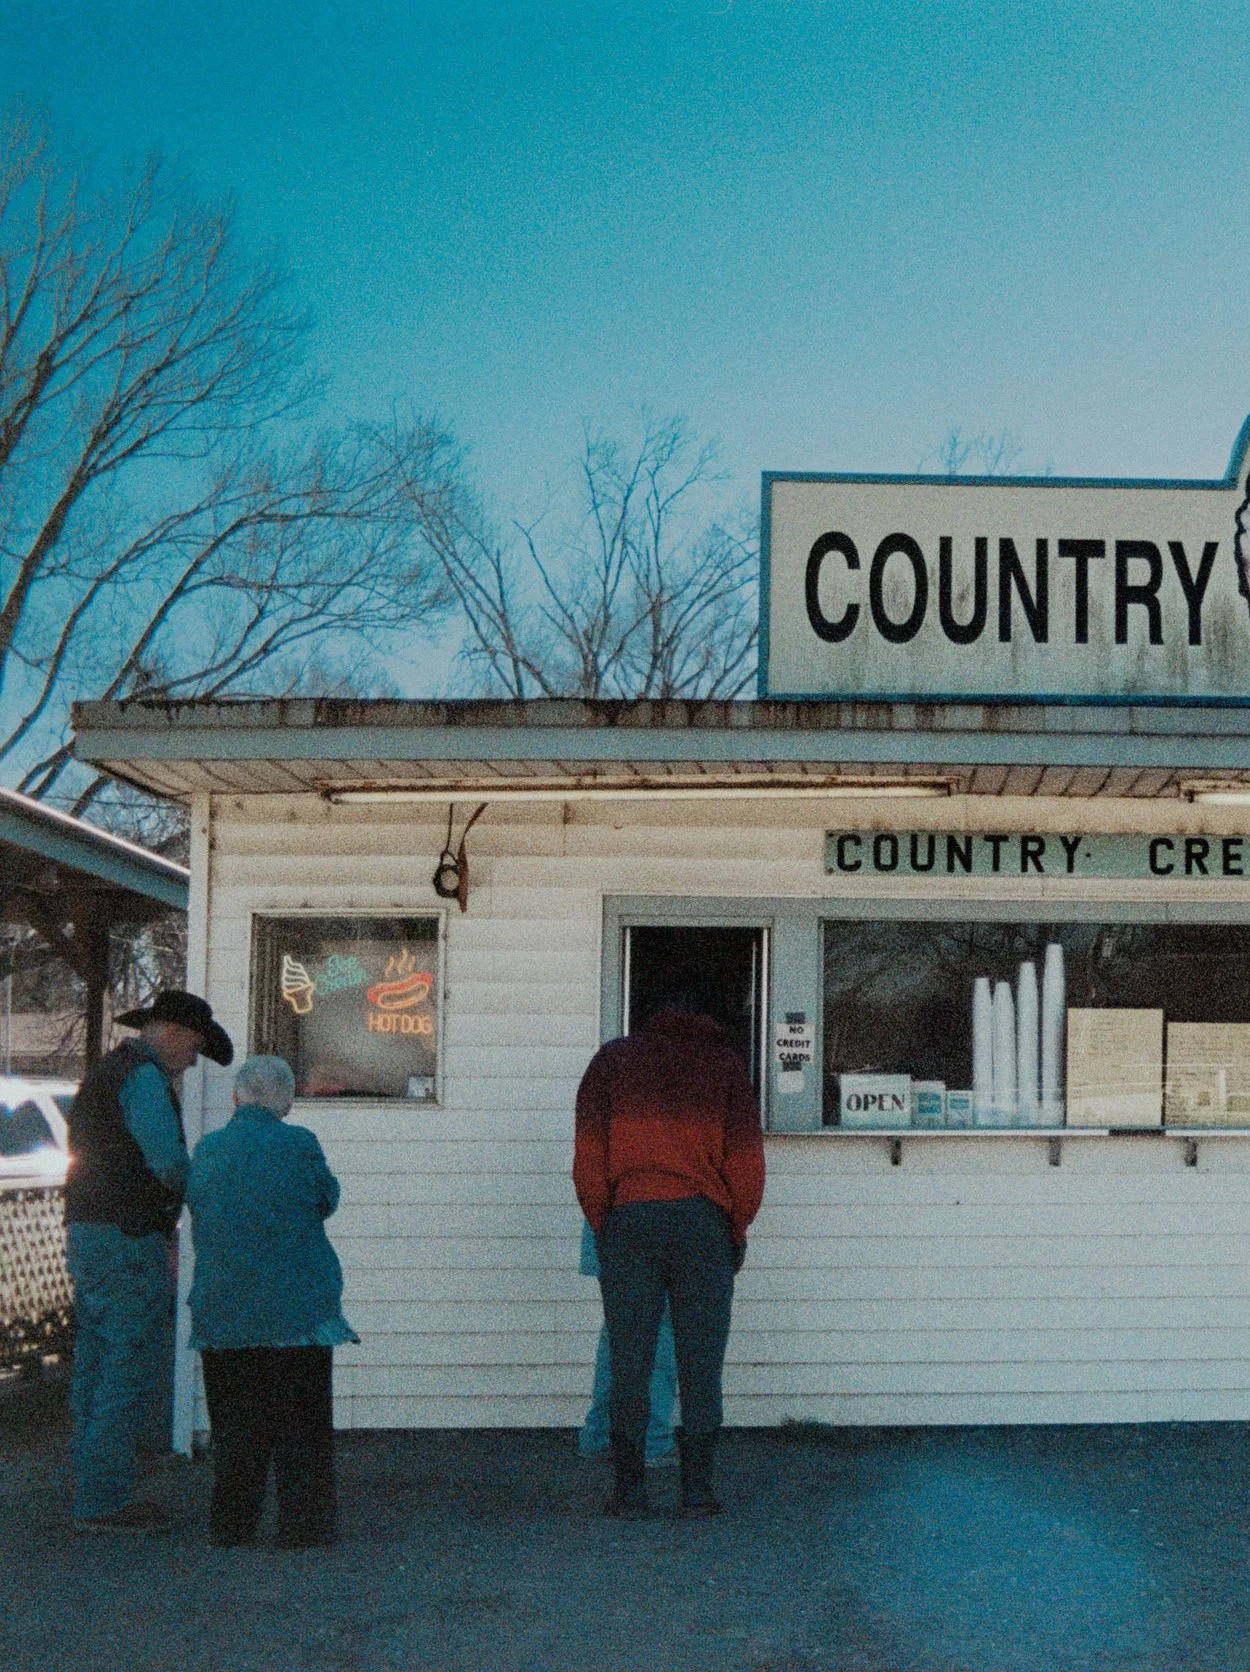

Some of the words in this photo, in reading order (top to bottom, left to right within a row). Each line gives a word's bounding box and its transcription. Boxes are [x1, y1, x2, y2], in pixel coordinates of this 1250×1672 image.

[805, 531, 1220, 646] COUNTRY
[836, 834, 1083, 874] COUNTRY
[789, 1025, 805, 1035] NO
[776, 1039, 811, 1049] CREDIT
[779, 1052, 811, 1063] CARDS
[846, 1094, 905, 1112] OPEN
